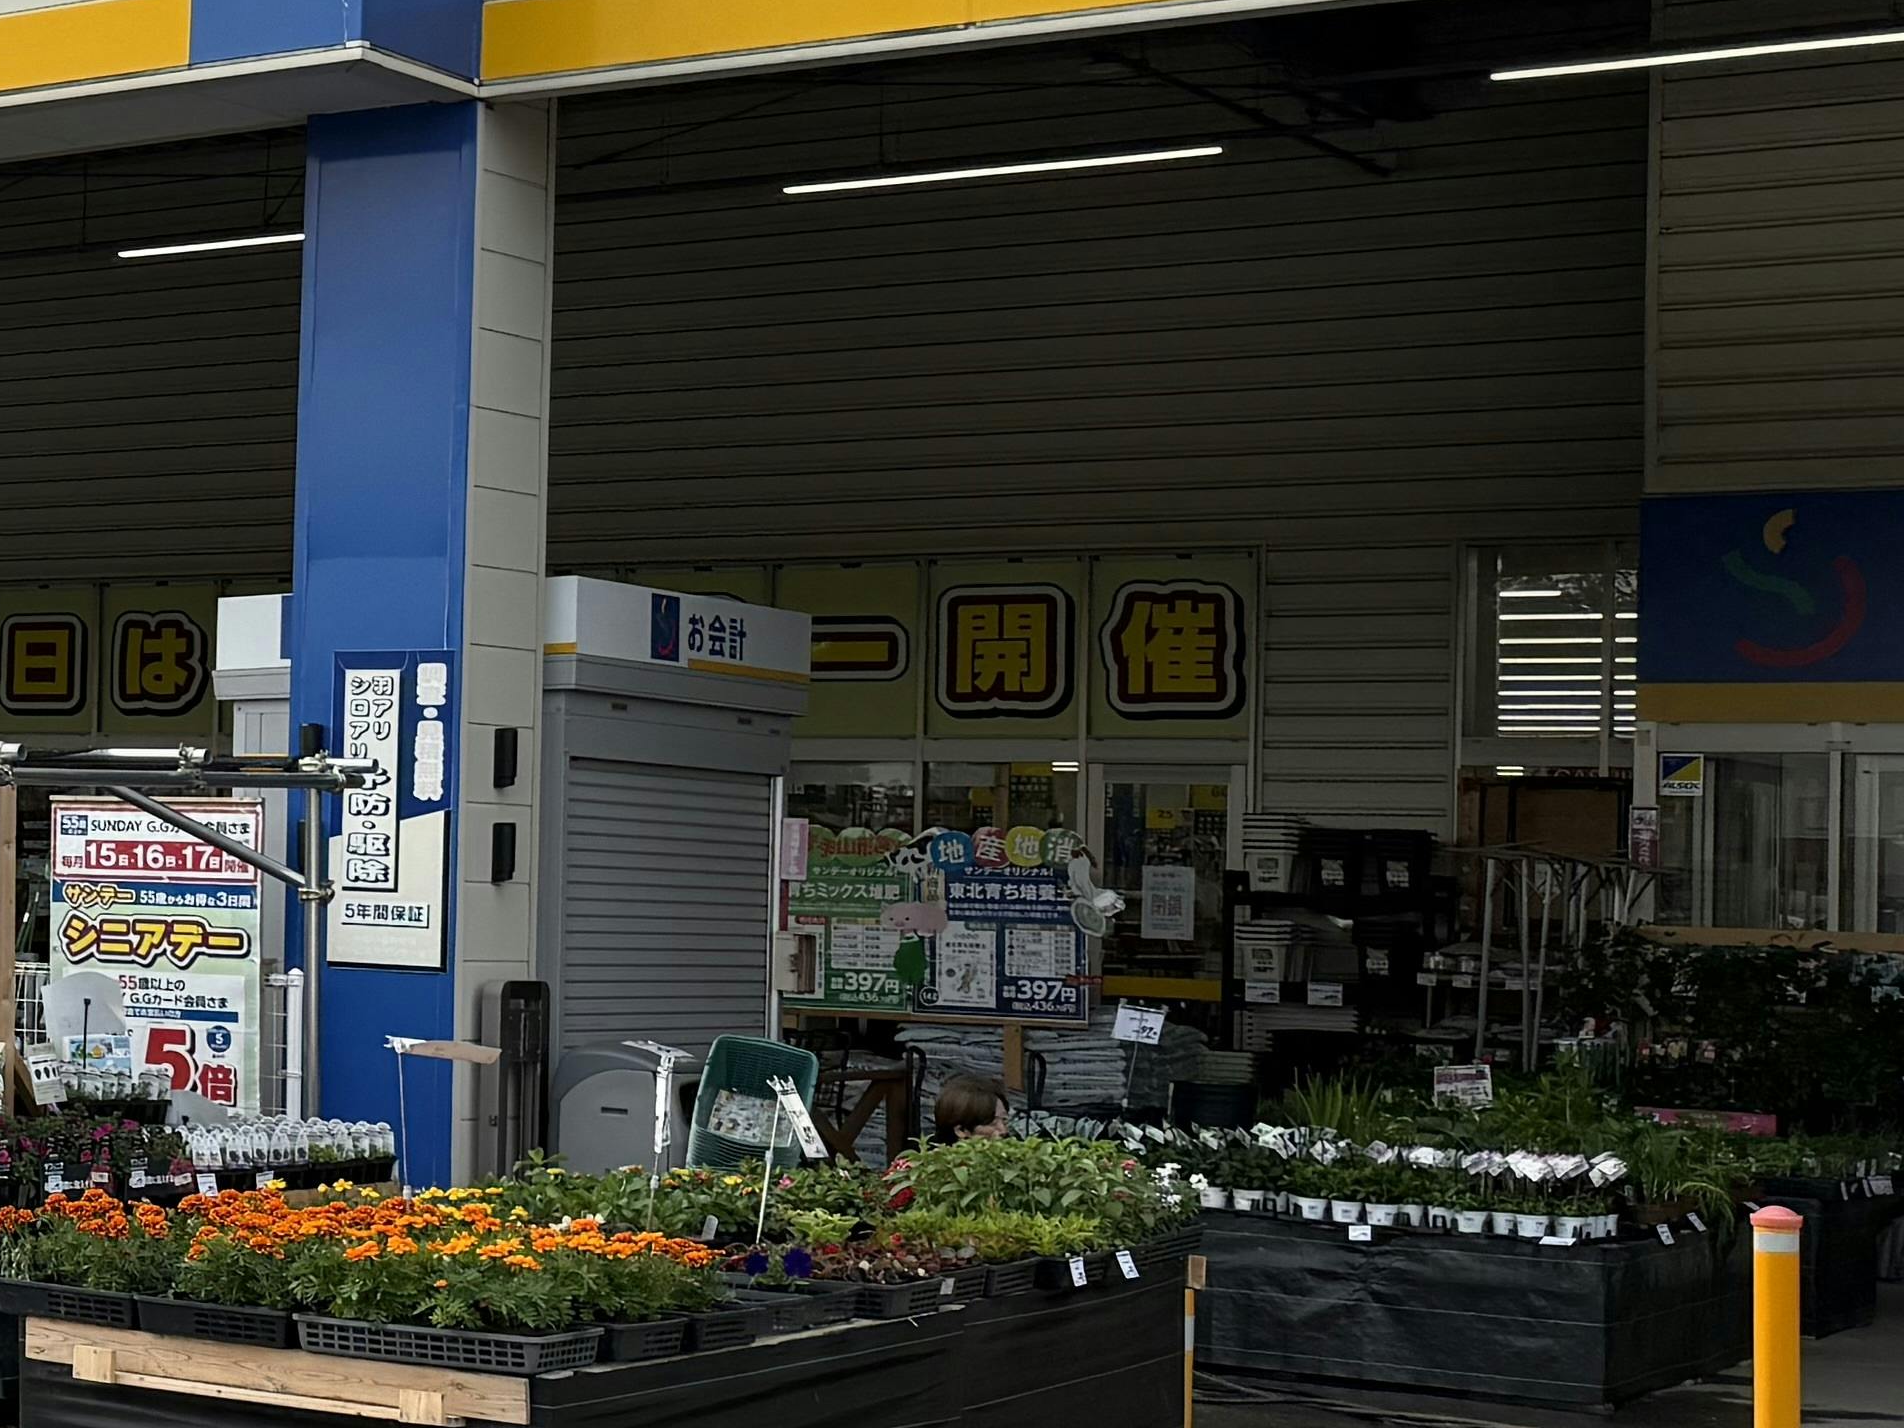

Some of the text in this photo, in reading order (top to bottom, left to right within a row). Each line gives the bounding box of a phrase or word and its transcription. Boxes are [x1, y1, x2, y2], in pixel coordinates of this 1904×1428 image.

[688, 613, 746, 661] お会計
[91, 820, 142, 832] SUNDAY
[938, 836, 1073, 865] 地産地消
[65, 884, 134, 908] サンデー
[344, 903, 425, 923] 5年間保証
[62, 914, 248, 965] シニアデー
[844, 972, 900, 994] 397円
[1017, 980, 1076, 1002] 397円
